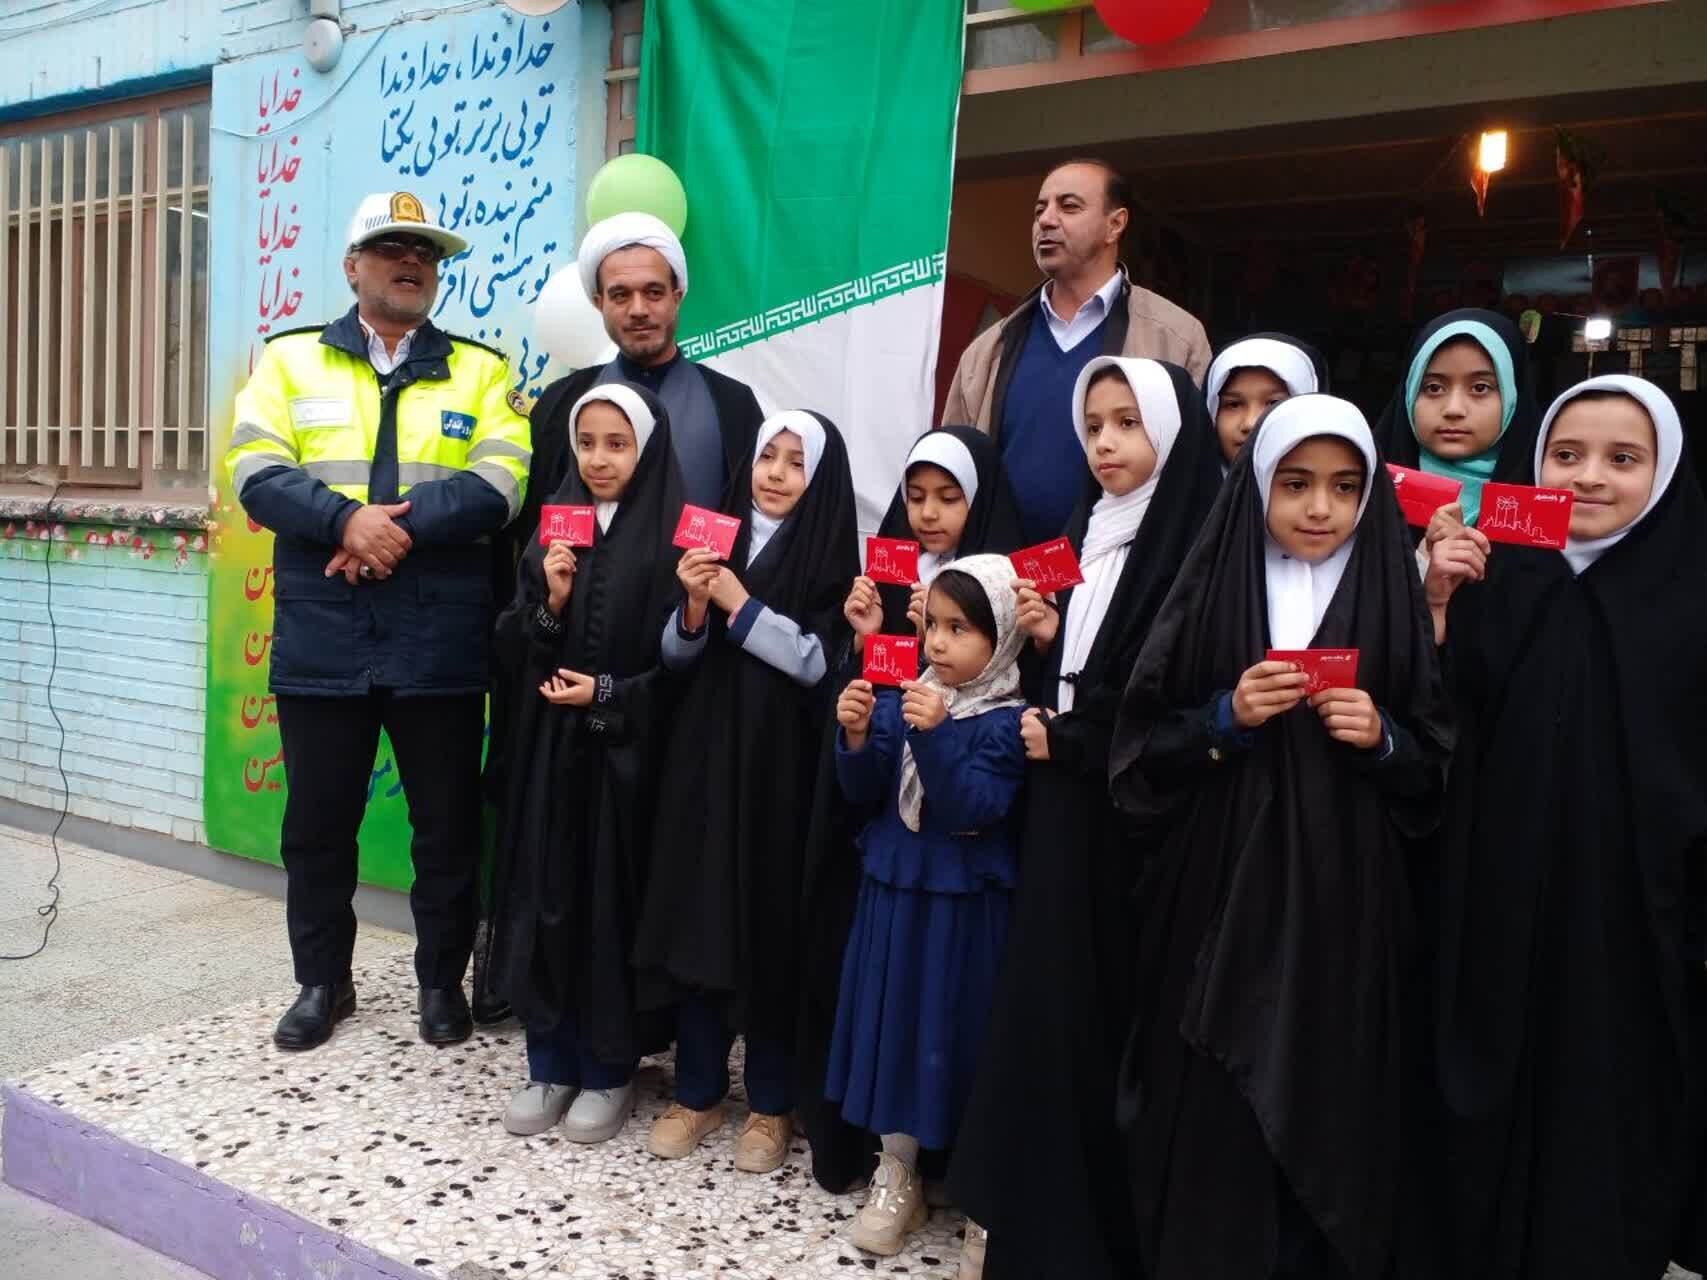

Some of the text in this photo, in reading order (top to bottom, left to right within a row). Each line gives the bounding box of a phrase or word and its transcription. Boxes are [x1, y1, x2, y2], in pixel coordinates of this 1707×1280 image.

[256, 67, 302, 135] خدایا
[380, 41, 451, 98] خداوندا
[381, 99, 415, 175] یکتا
[502, 82, 556, 169] تویی
[257, 135, 302, 198] خدایا
[257, 201, 302, 265] خدایا
[514, 176, 553, 256] منم
[257, 265, 303, 333] خدایا
[469, 252, 533, 318] هستی
